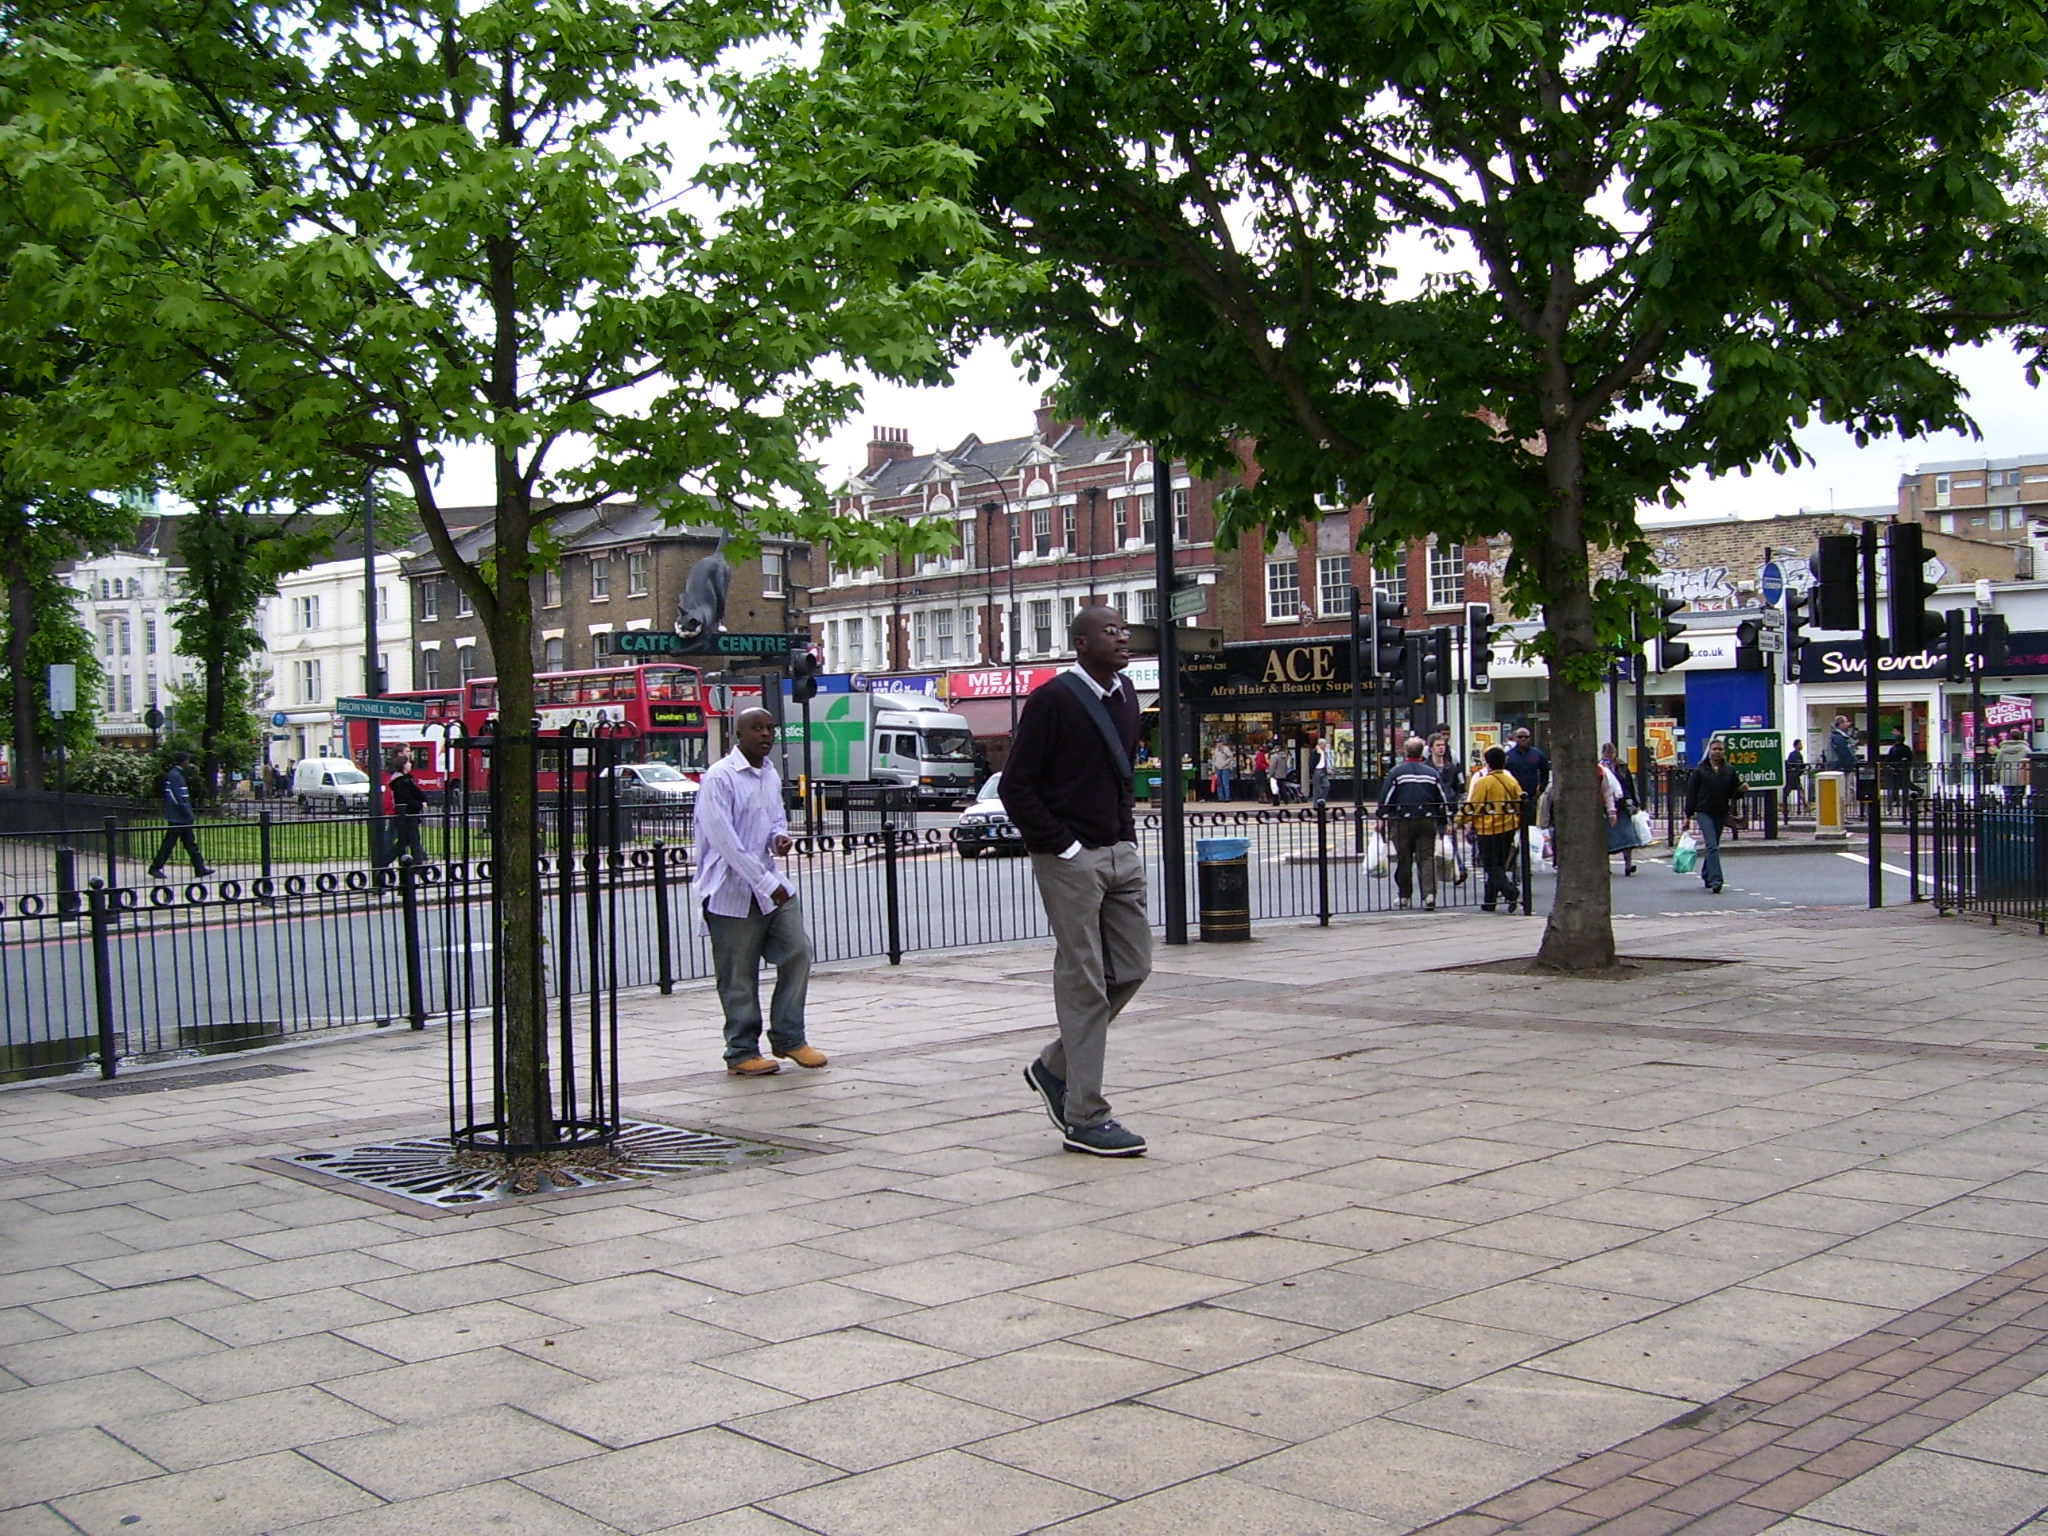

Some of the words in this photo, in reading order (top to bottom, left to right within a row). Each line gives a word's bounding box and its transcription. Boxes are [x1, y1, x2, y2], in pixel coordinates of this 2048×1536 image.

[718, 636, 787, 651] CENTRE
[1261, 646, 1335, 682] ACE
[968, 670, 1034, 687] MEAT
[1210, 685, 1235, 696] Afro
[1238, 684, 1264, 696] Hair
[1268, 682, 1279, 694] &
[1282, 680, 1322, 695] Beauty
[338, 701, 384, 714] BROWNHILL
[389, 705, 412, 716] ROAD
[655, 712, 684, 720] Lewisham
[1985, 703, 2015, 718] price
[1987, 707, 2032, 725] crash
[1727, 737, 1738, 750] S.
[1740, 737, 1779, 750] Circular
[1736, 769, 1777, 782] oolwich
